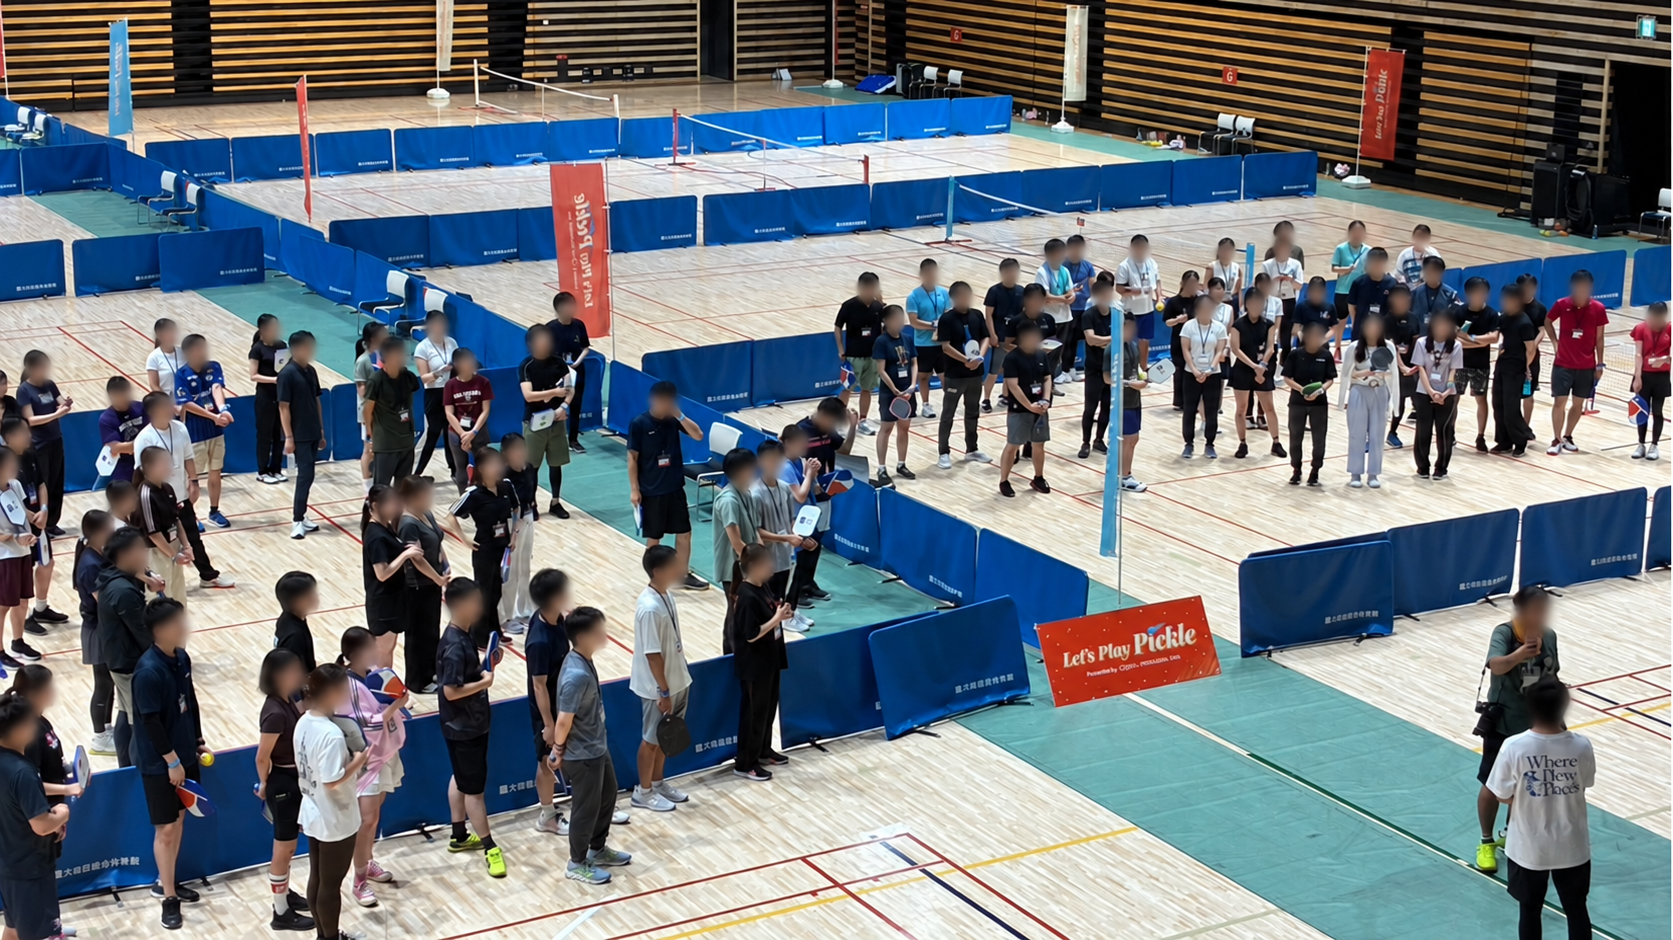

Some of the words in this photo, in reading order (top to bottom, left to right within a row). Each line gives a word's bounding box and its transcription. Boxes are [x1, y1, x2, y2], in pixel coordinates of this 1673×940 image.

[1226, 71, 1233, 82] G
[1063, 648, 1095, 668] Let's
[1098, 643, 1131, 661] Play
[1133, 623, 1197, 655] Pickle
[1526, 754, 1578, 769] Where
